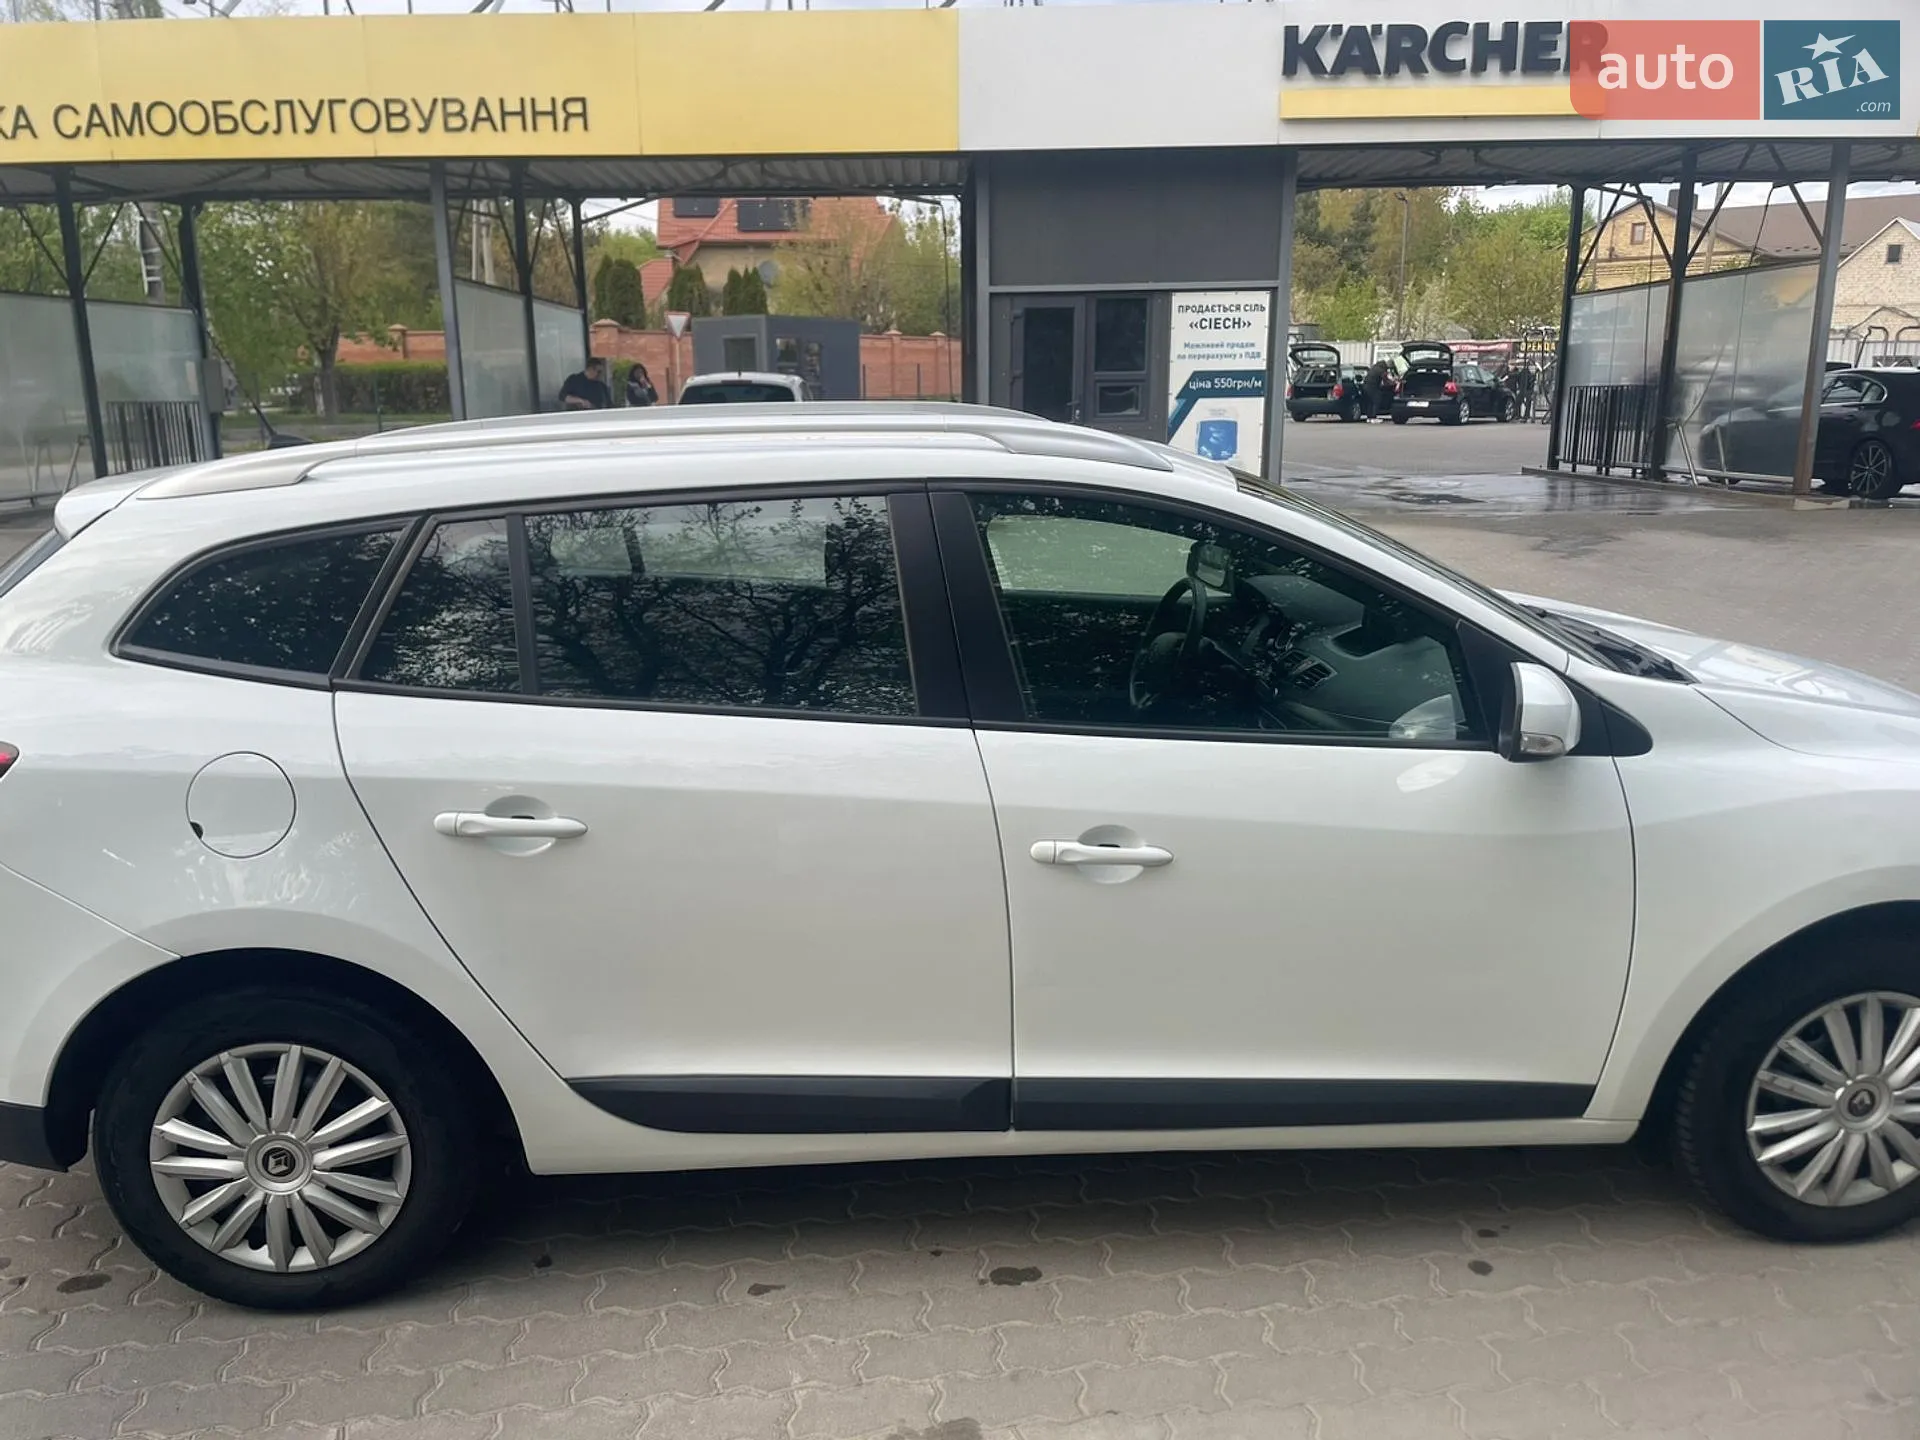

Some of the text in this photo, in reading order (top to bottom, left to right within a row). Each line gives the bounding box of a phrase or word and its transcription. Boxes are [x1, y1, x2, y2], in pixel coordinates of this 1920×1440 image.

[1282, 20, 1609, 77] KÄRCHER
[53, 96, 589, 139] САМООБСЛУГОВУВАННЯ
[1178, 303, 1266, 314] ПРОДАЄТЬСЯ СІЛЬ
[1189, 379, 1212, 390] ціна
